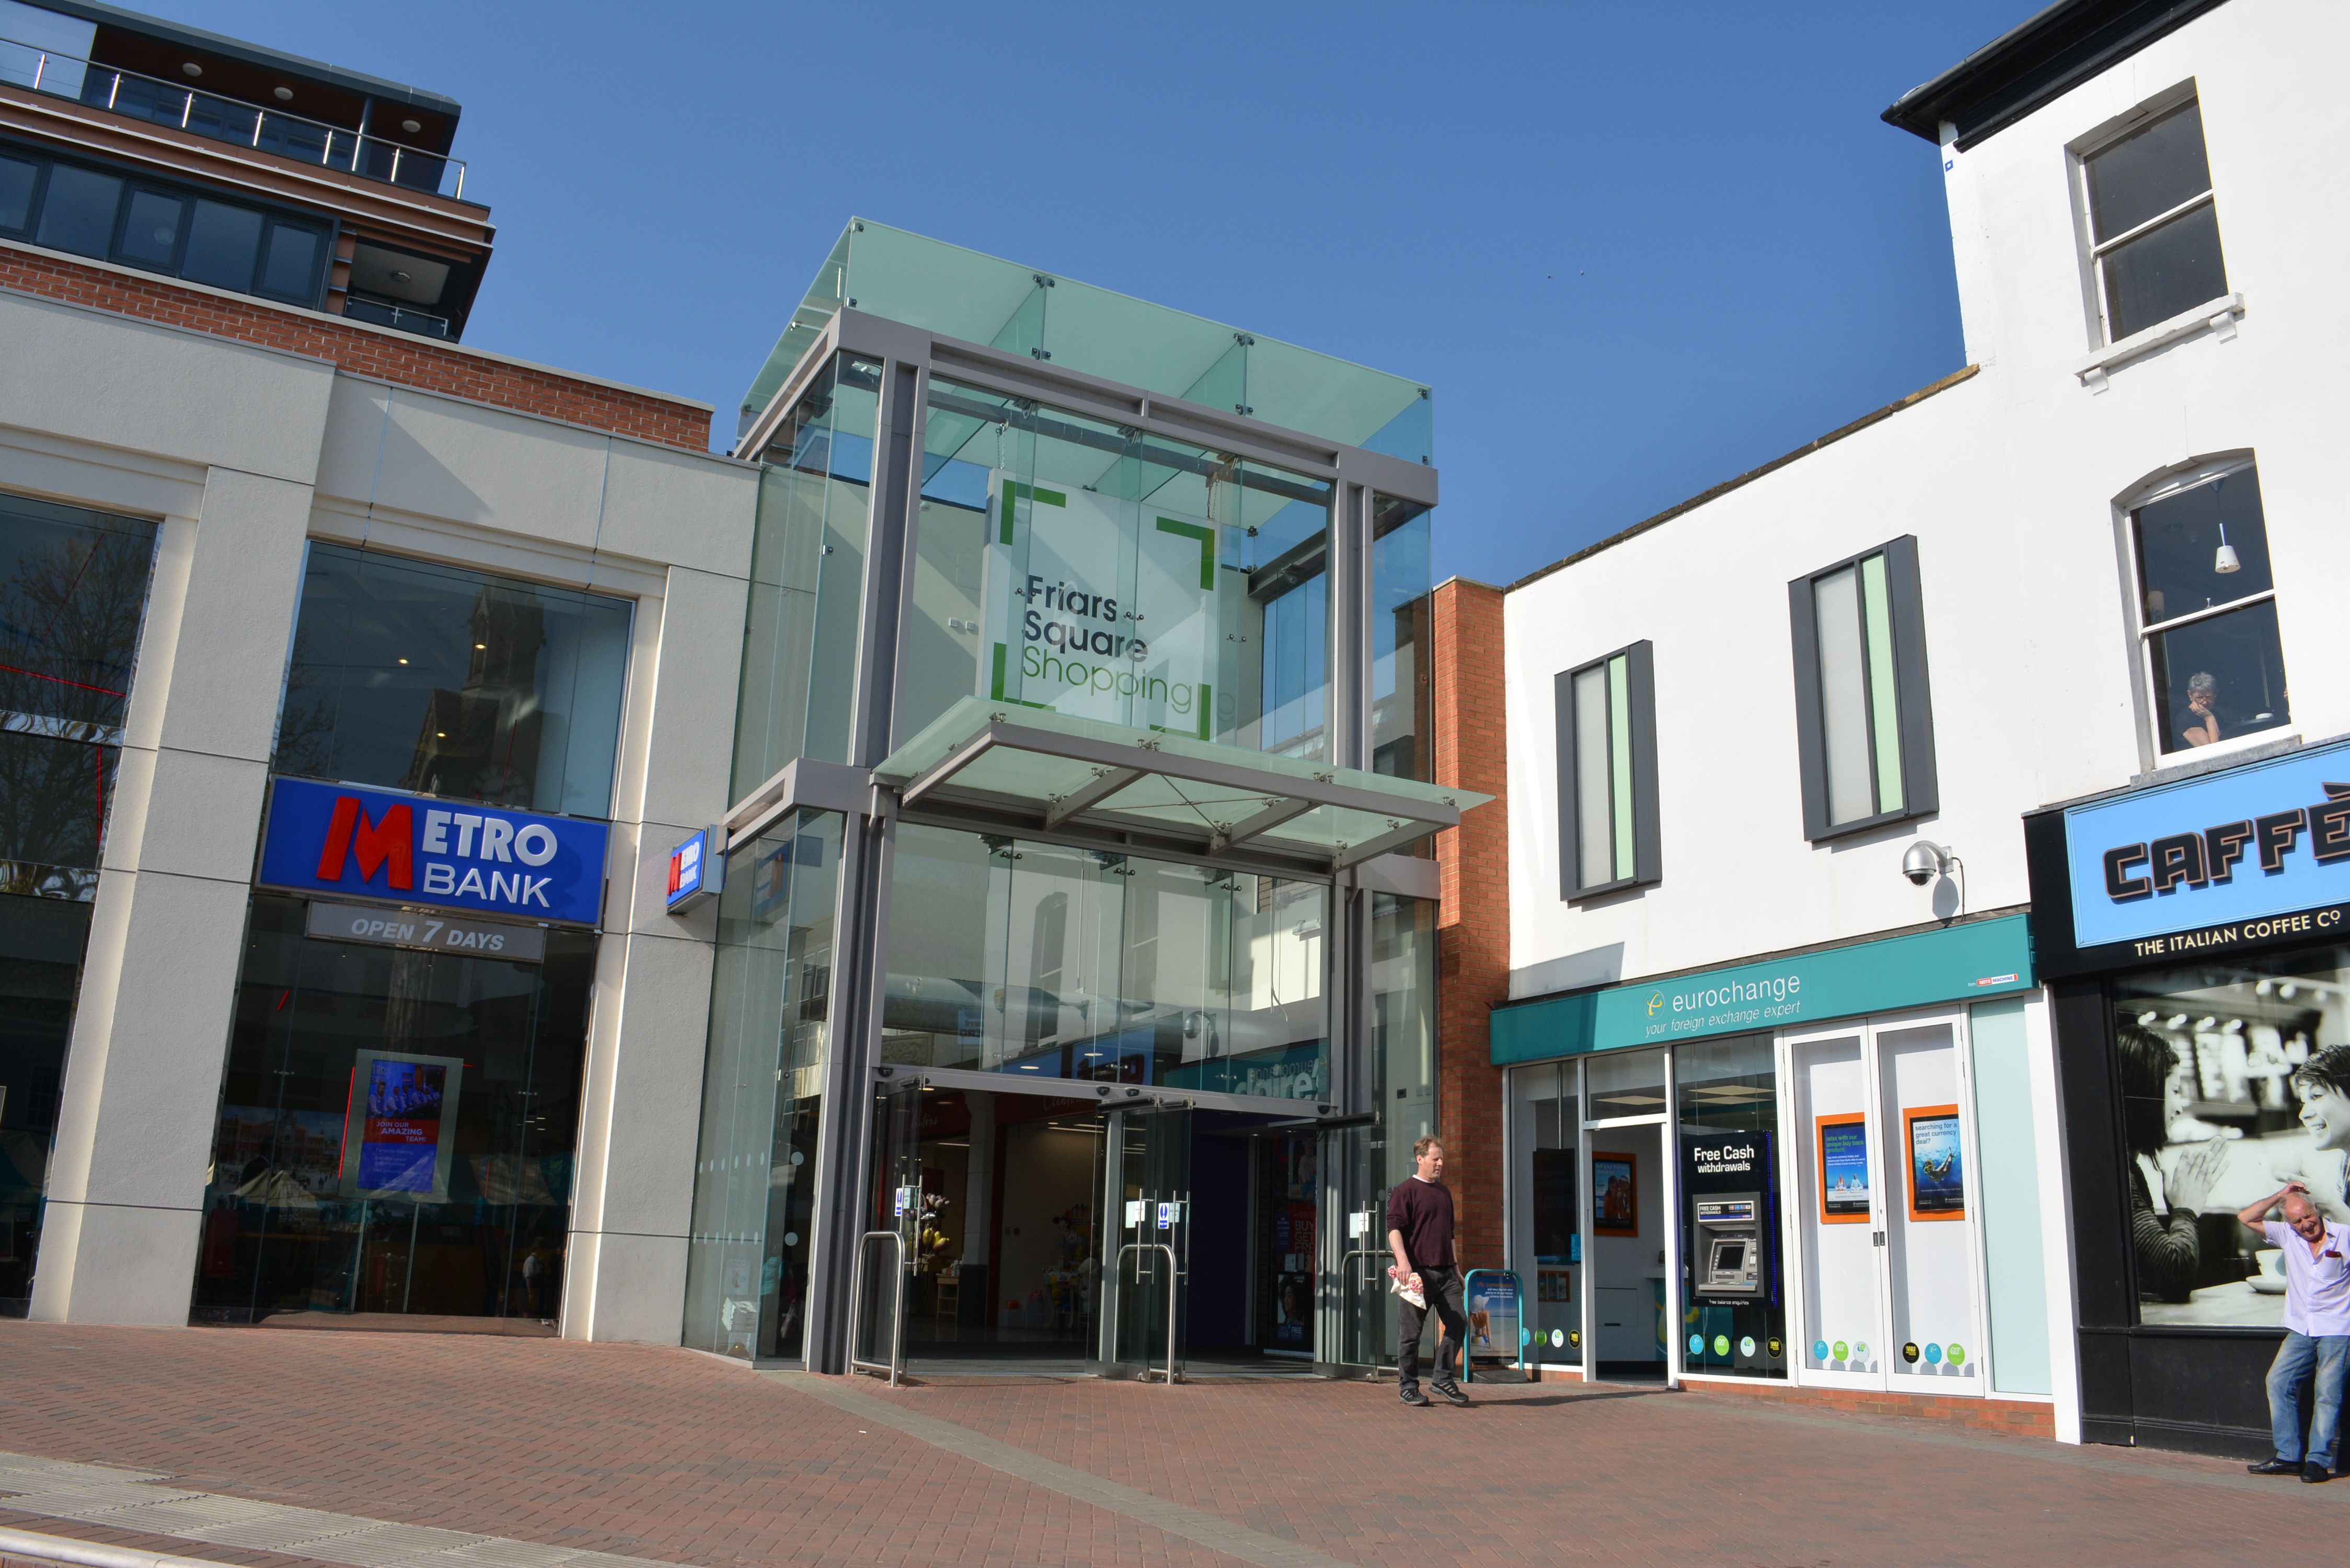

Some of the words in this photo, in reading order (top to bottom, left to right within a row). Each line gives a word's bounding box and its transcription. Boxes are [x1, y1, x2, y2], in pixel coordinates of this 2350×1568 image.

[1027, 574, 1117, 622] Friars
[1023, 610, 1148, 663] Square
[1022, 645, 1192, 714] Shopping
[316, 796, 558, 890] METRO
[423, 862, 552, 908] BANK
[351, 918, 415, 941] OPEN
[423, 920, 444, 943] 7
[446, 929, 504, 951] DAYS
[2135, 940, 2164, 956] THE
[2170, 927, 2237, 951] ITALIAN
[2243, 915, 2311, 939] COFFEE
[1673, 975, 1800, 1012] eurochange
[1646, 1023, 1667, 1037] your
[1671, 1018, 1704, 1032] foreign
[1709, 1007, 1760, 1026] exchange
[1764, 1000, 1801, 1018] expert
[1915, 1123, 1942, 1132] searching
[1694, 1147, 1721, 1162] Free
[1723, 1144, 1755, 1160] Cash
[1697, 1160, 1751, 1173] withdrawals
[1294, 1231, 1314, 1242] GET
[1295, 1220, 1314, 1231] BUY
